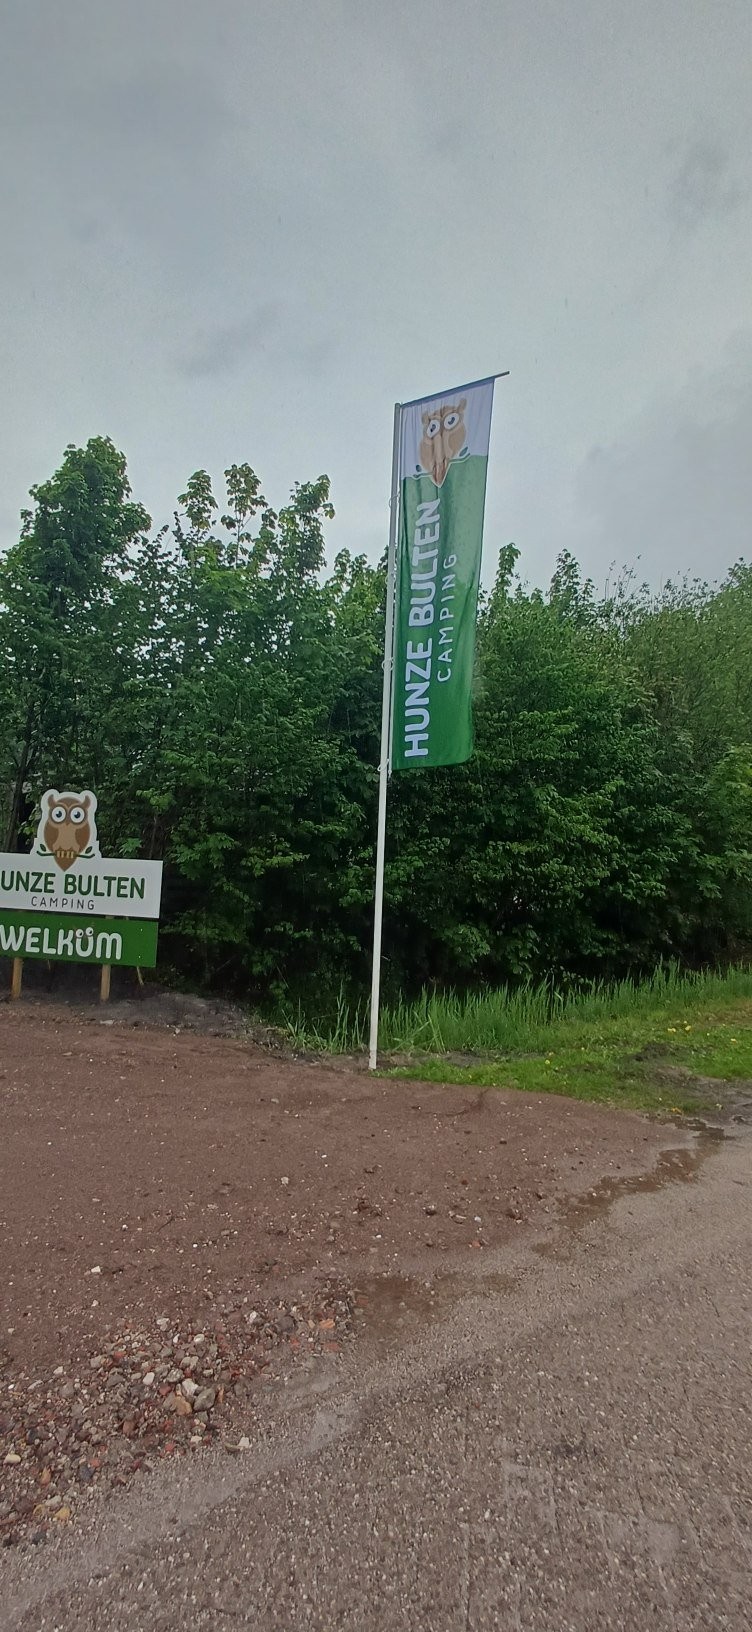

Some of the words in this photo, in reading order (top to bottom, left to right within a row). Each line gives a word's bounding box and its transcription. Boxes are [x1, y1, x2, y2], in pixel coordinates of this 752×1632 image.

[409, 498, 441, 627] BULTEN
[437, 554, 457, 682] CAMPING
[404, 638, 433, 758] HUNZE
[0, 870, 56, 894] UNZE
[64, 874, 146, 899] BULTEN
[31, 896, 95, 910] CAMPING
